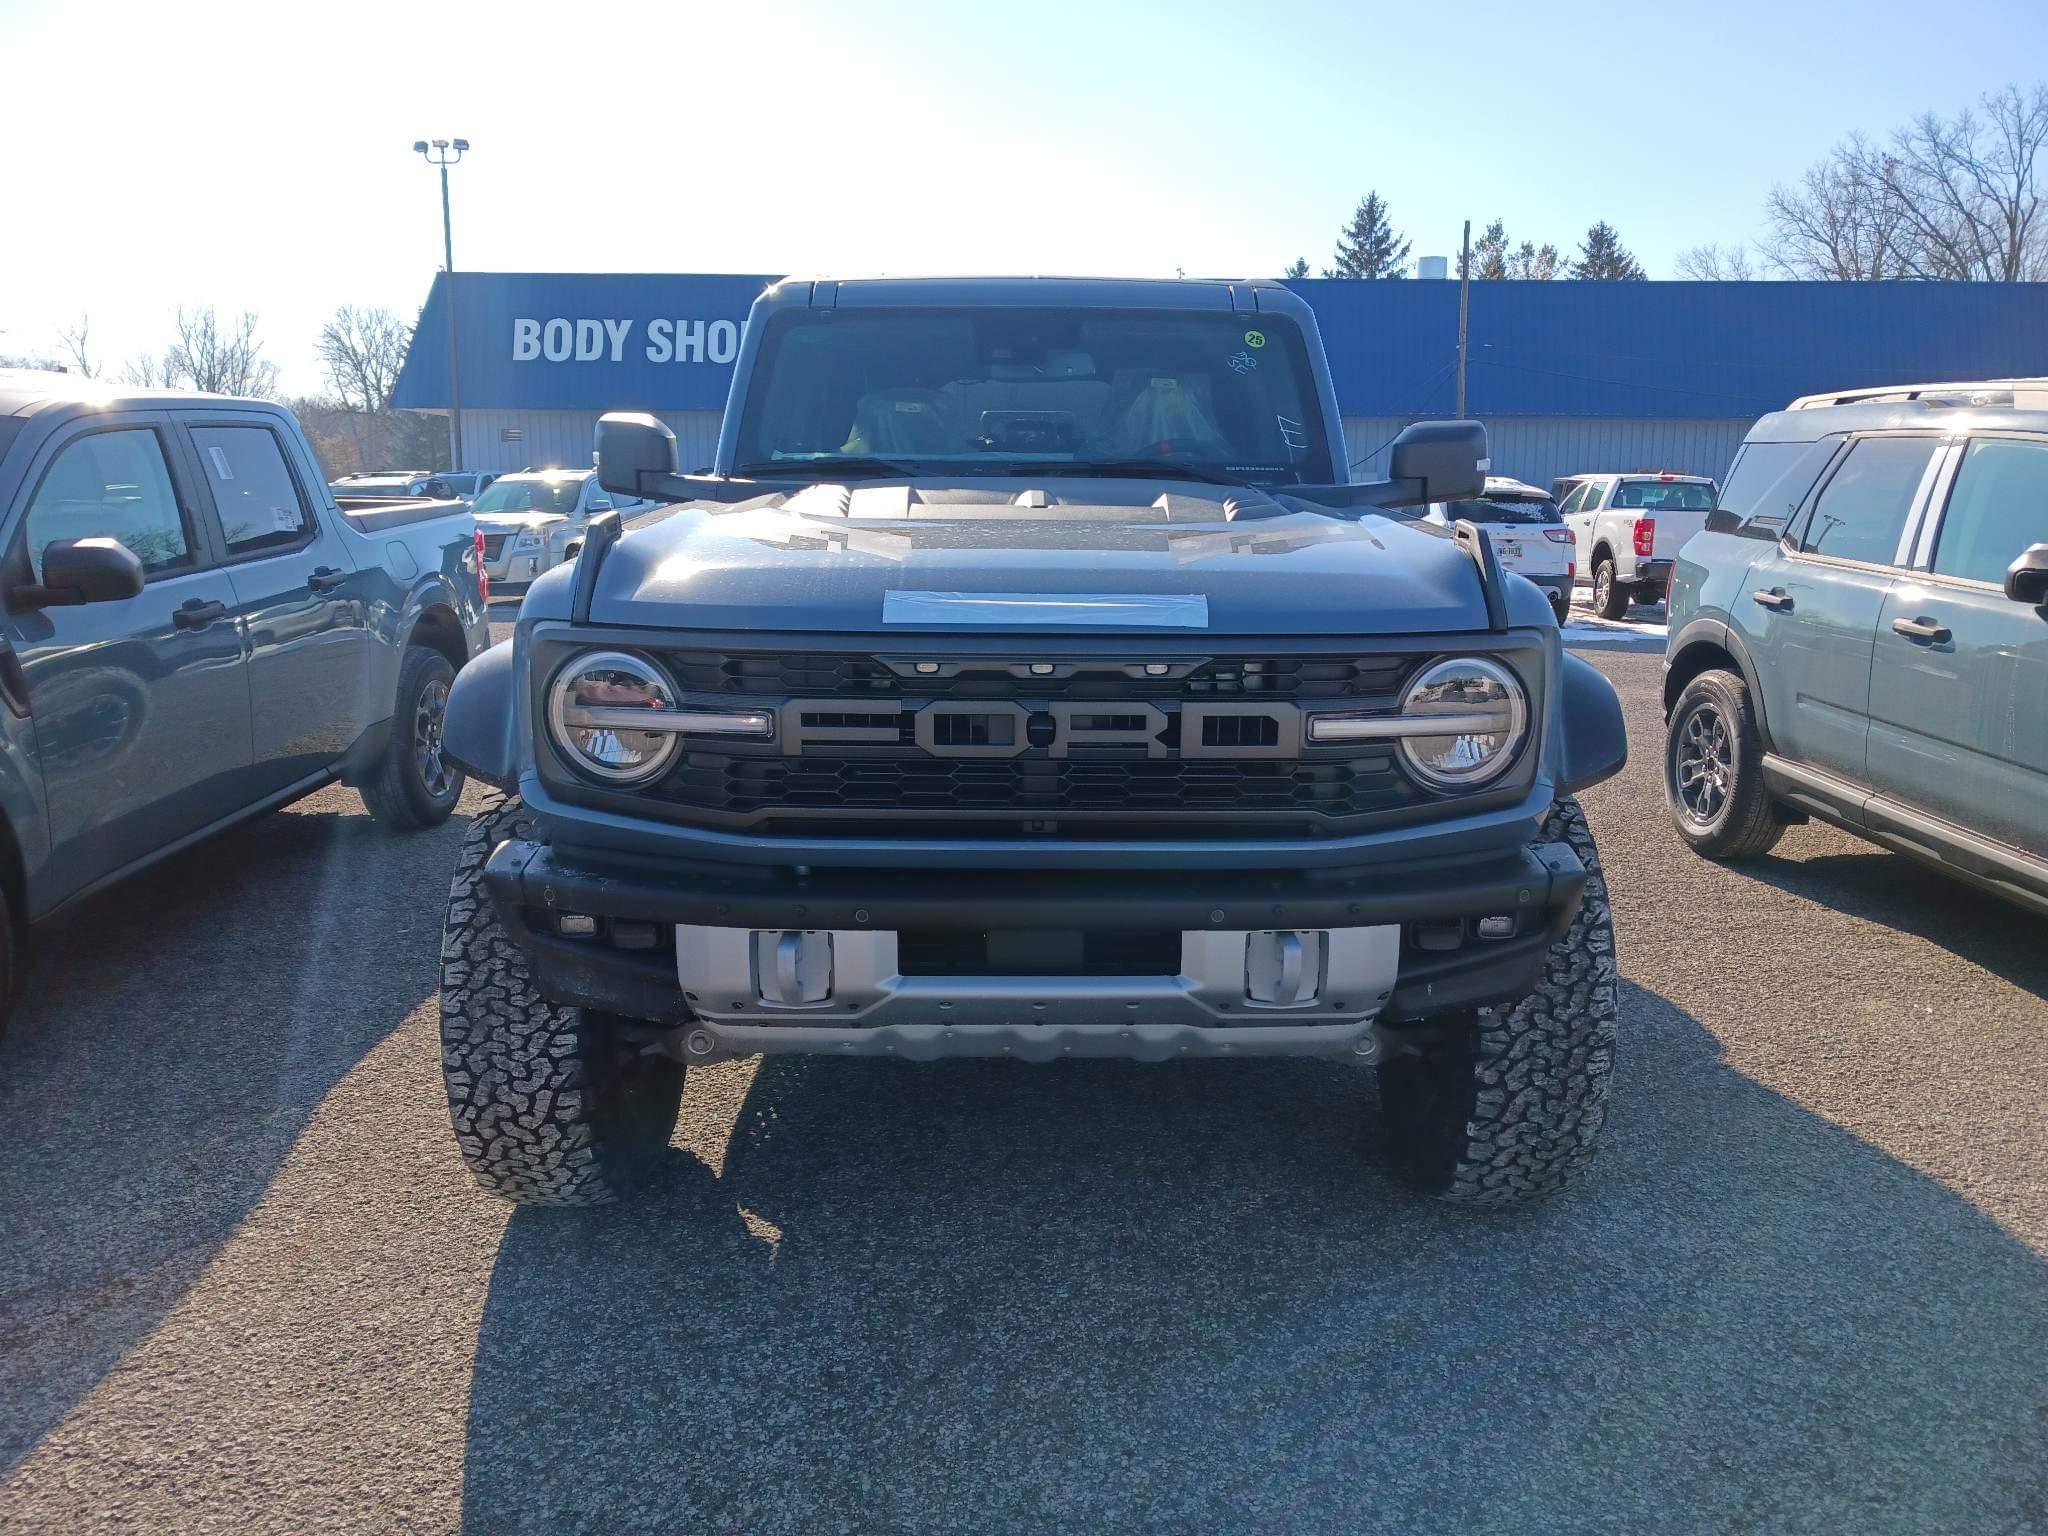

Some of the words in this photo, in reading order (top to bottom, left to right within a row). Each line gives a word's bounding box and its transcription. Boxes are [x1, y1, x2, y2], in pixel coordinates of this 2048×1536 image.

[512, 317, 634, 362] BODY
[1247, 333, 1263, 346] 25
[781, 699, 1301, 760] FORD
